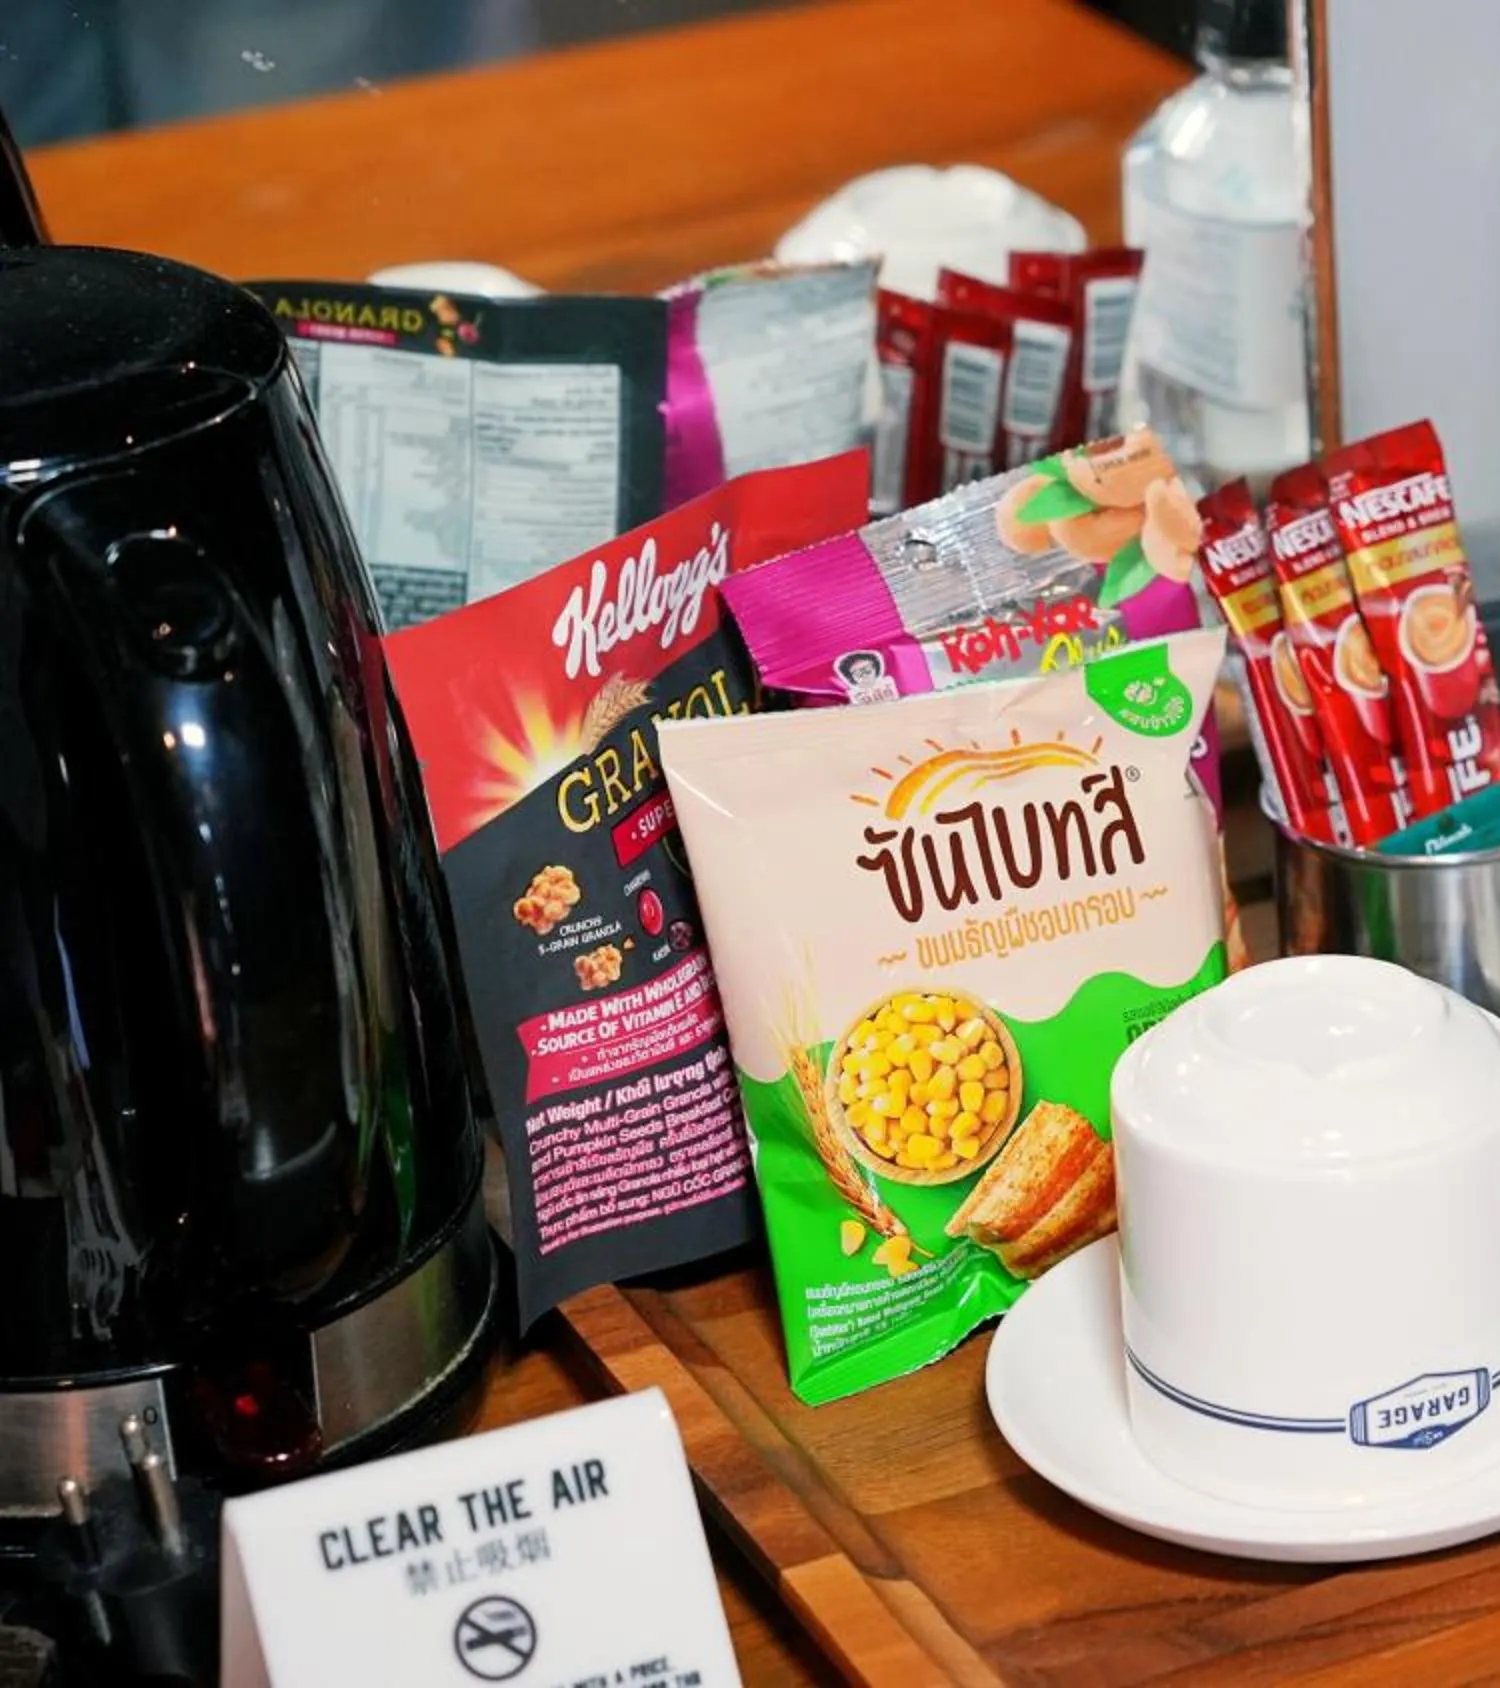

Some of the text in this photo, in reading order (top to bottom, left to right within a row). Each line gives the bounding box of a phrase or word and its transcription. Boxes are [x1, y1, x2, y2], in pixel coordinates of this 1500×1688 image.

[551, 521, 730, 681] Kellogg's
[638, 798, 676, 839] SUPE
[547, 1096, 603, 1123] Weight
[1376, 1386, 1470, 1430] GARAGE
[319, 1458, 611, 1572] CLEAR THE AIR
[403, 1529, 553, 1597] 禁止吸烟
